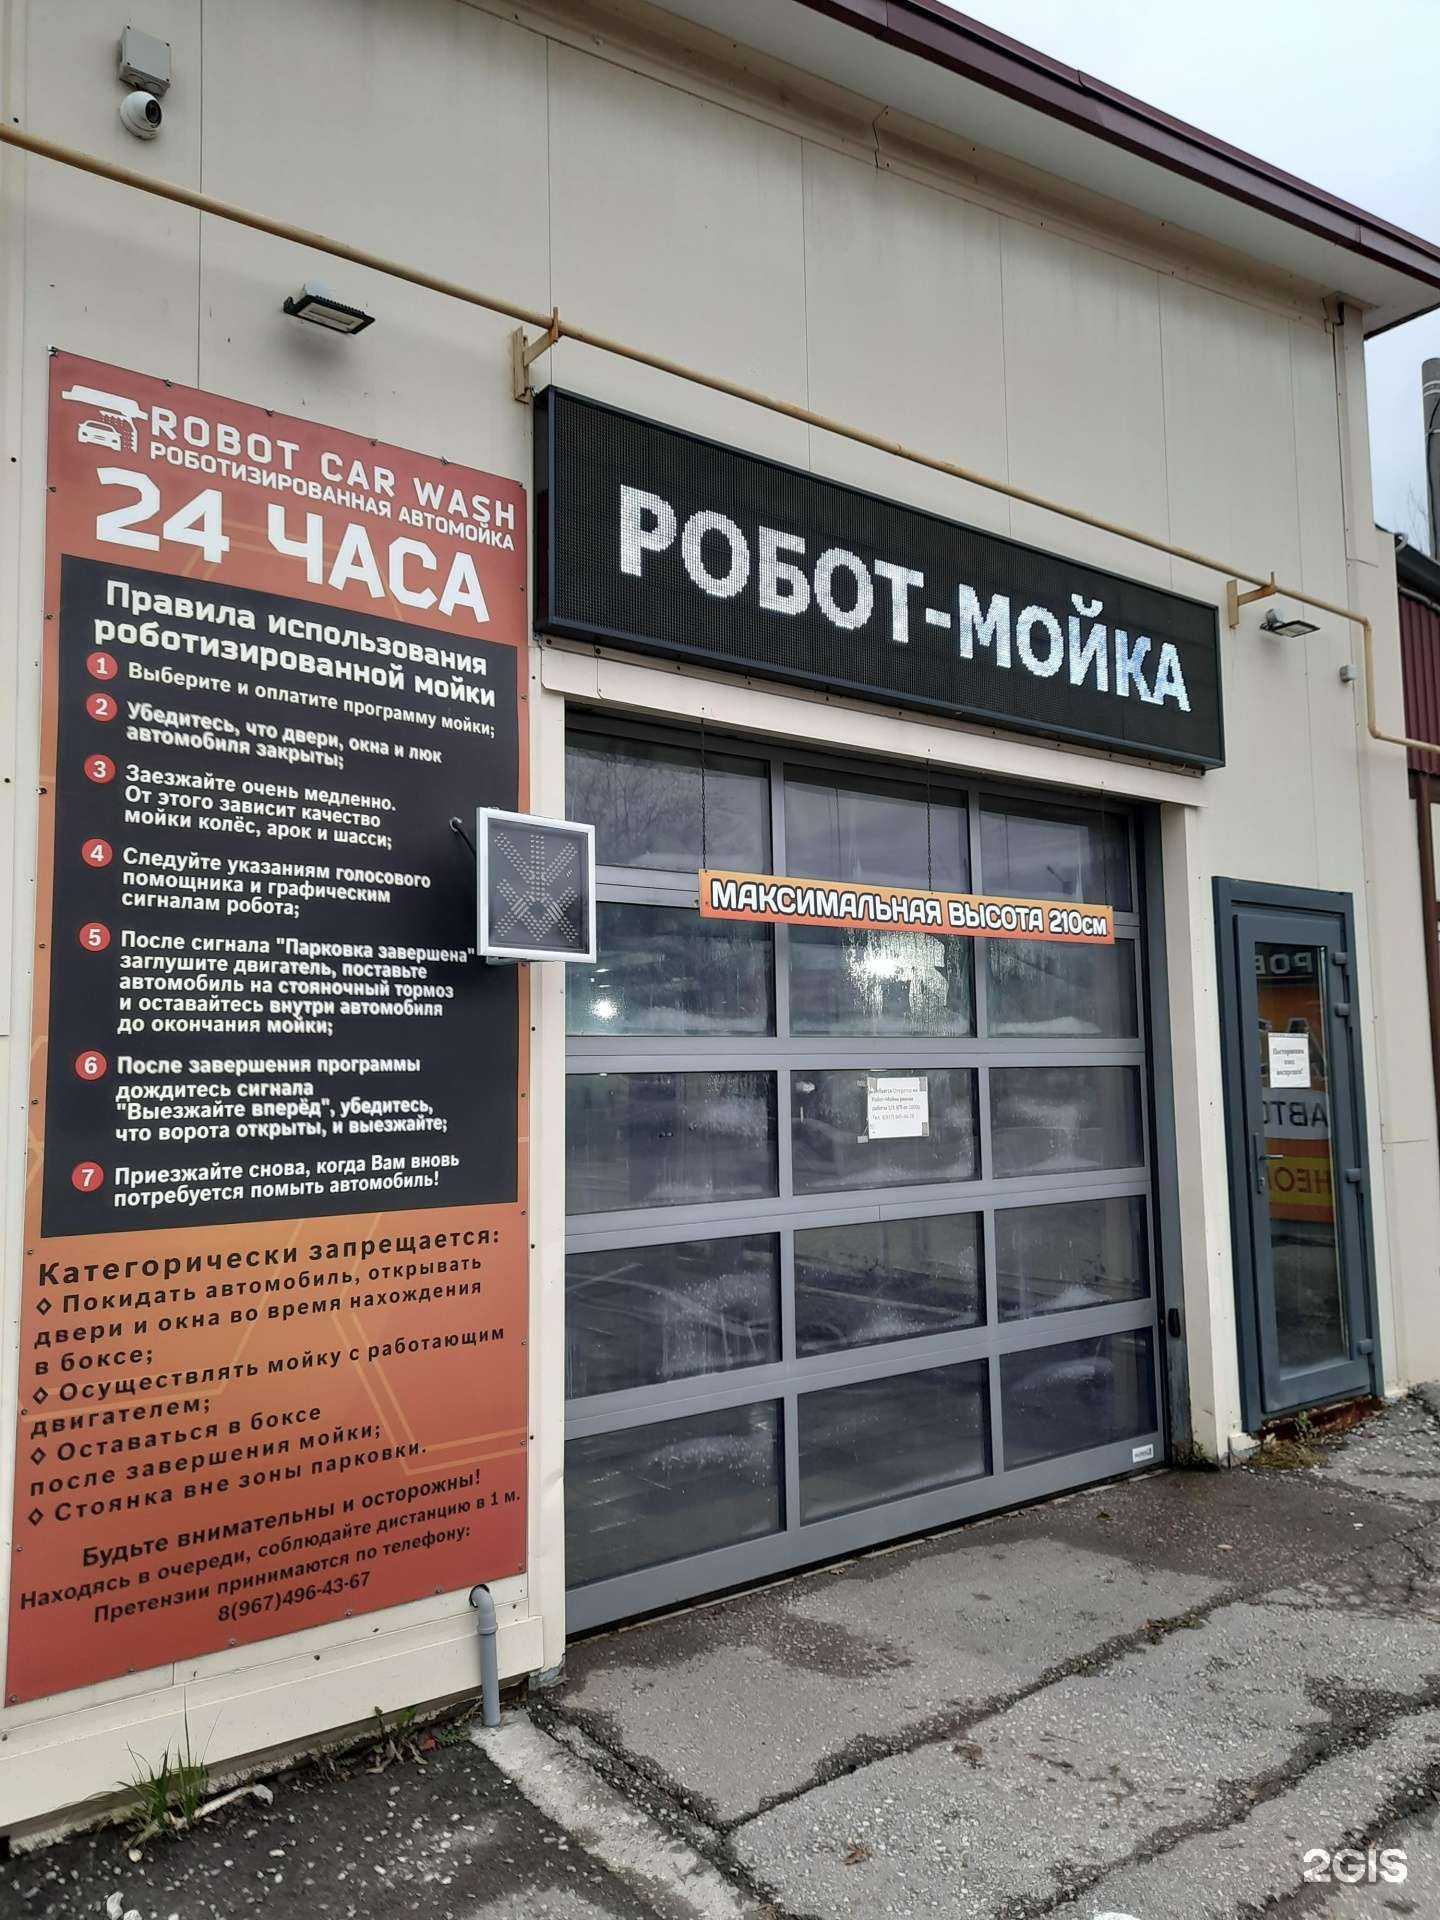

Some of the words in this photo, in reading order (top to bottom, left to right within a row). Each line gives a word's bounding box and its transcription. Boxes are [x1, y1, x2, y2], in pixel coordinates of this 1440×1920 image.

[151, 405, 299, 470] ROBOT
[321, 451, 395, 497] CAR
[413, 478, 515, 530] WASH
[150, 441, 391, 518] РОБОТИЗИРОВАННАЯ
[399, 505, 514, 551] АВТОМОЙКА
[96, 467, 230, 564] 24
[268, 503, 490, 623] ЧАСА
[619, 484, 1192, 712] РОБОТ-МОЙКА
[107, 579, 255, 630] Правила
[268, 613, 487, 675] использования
[94, 618, 403, 689] роботизированной
[415, 675, 496, 707] мойки
[96, 658, 108, 674] 1
[128, 662, 231, 692] Выберите
[237, 681, 249, 695] и
[255, 685, 338, 710] оплатите
[343, 695, 436, 729] программу
[441, 713, 495, 739] мойки;
[95, 699, 109, 715] 2
[126, 701, 240, 736] Убедитесь,
[247, 722, 277, 739] что
[282, 727, 344, 752] двери,
[349, 738, 389, 757] окна
[394, 744, 403, 758] и
[408, 746, 442, 764] люк
[126, 725, 250, 754] автомобиля
[256, 744, 344, 769] закрыты;
[93, 761, 106, 778] 3
[126, 764, 236, 793] Заезжайте
[242, 780, 299, 799] очень
[305, 787, 396, 812] медленно.
[125, 786, 151, 803] От
[157, 789, 214, 812] этого
[219, 797, 296, 818] зависит
[301, 806, 381, 828] качество
[124, 809, 191, 828] мойки
[198, 815, 261, 836] колёс,
[267, 822, 311, 842] арок
[317, 827, 327, 840] и
[333, 829, 392, 850] шасси;
[90, 844, 104, 861] 4
[123, 848, 221, 875] Следуйте
[227, 858, 330, 880] указаниям
[336, 867, 431, 889] голосового
[122, 871, 244, 895] помощника
[249, 880, 261, 893] и
[268, 881, 391, 903] графическим
[121, 891, 220, 912] сигналам
[226, 898, 300, 918] робота;
[711, 880, 942, 925] МАКСИМАЛЬНАЯ
[948, 901, 1043, 932] ВЫСОТА
[1048, 910, 1107, 936] 210см
[88, 929, 102, 946] 5
[121, 930, 185, 950] После
[191, 936, 270, 954] сигнала
[276, 938, 373, 961] "Парковка
[378, 944, 475, 963] завершена"
[119, 953, 228, 975] заглушите
[233, 959, 337, 979] двигатель,
[342, 962, 428, 980] поставьте
[119, 974, 244, 993] автомобиль
[250, 979, 273, 993] на
[278, 979, 390, 998] стояночный
[394, 982, 454, 999] тормоз
[119, 997, 131, 1012] и
[138, 996, 264, 1014] оставайтесь
[269, 998, 334, 1023] внутри
[340, 999, 443, 1017] автомобиля
[117, 1018, 145, 1036] до
[152, 1017, 261, 1033] окончания
[267, 1014, 334, 1038] мойки;
[84, 1057, 97, 1074] 6
[117, 1057, 183, 1075] После
[189, 1057, 312, 1075] завершения
[317, 1057, 420, 1079] программы
[116, 1081, 231, 1103] дождитесь
[237, 1080, 314, 1098] сигнала
[116, 1126, 151, 1141] что
[158, 1123, 230, 1141] ворота
[235, 1120, 327, 1140] открыты,
[332, 1121, 343, 1134] и
[349, 1113, 448, 1134] выезжайте;
[117, 1100, 246, 1121] "Выезжайте
[252, 1095, 335, 1118] вперёд",
[340, 1097, 434, 1118] убедитесь,
[82, 1169, 93, 1186] 7
[115, 1163, 243, 1185] Приезжайте
[249, 1159, 311, 1181] снова,
[316, 1156, 366, 1177] когда
[371, 1154, 406, 1171] Вам
[411, 1152, 460, 1169] вновь
[113, 1184, 244, 1209] потребуется
[250, 1179, 324, 1199] помыть
[329, 1172, 439, 1192] автомобиль!
[38, 1246, 298, 1286] Категорически
[308, 1228, 500, 1262] запрещается:
[62, 1285, 196, 1314] Покидать
[206, 1269, 360, 1300] автомобиль,
[368, 1256, 482, 1285] открывать
[34, 1322, 124, 1349] двери
[134, 1320, 147, 1335] и
[158, 1309, 220, 1333] окна
[230, 1307, 258, 1323] во
[267, 1298, 341, 1324] время
[350, 1279, 482, 1310] нахождения
[35, 1360, 49, 1375] в
[61, 1345, 153, 1370] боксе;
[59, 1361, 258, 1403] Осуществлять
[268, 1347, 341, 1374] мойку
[349, 1348, 359, 1361] с
[367, 1325, 504, 1362] работающим
[30, 1398, 211, 1440] двигателем;
[57, 1423, 219, 1463] Оставаться
[228, 1421, 241, 1435] в
[251, 1405, 322, 1431] боксе
[30, 1468, 116, 1496] после
[126, 1441, 290, 1480] завершения
[299, 1423, 381, 1452] мойки;
[54, 1485, 174, 1523] Стоянка
[184, 1476, 230, 1499] вне
[238, 1464, 302, 1489] зоны
[311, 1439, 427, 1476] парковки.
[82, 1535, 169, 1569] Будьте
[177, 1503, 336, 1549] внимательны
[343, 1500, 354, 1513] и
[361, 1468, 481, 1508] осторожны!
[20, 1576, 130, 1610] Находясь
[138, 1569, 151, 1584] в
[157, 1548, 251, 1582] очереди,
[257, 1522, 373, 1560] соблюдайте
[376, 1501, 472, 1536] дистанцию
[476, 1495, 485, 1509] в
[489, 1491, 500, 1506] 1
[505, 1490, 521, 1504] м.
[94, 1583, 210, 1623] Претензии
[217, 1553, 350, 1597] принимаются
[356, 1546, 378, 1564] по
[382, 1528, 471, 1558] телефону:
[218, 1571, 370, 1624] 8(967)496-43-67
